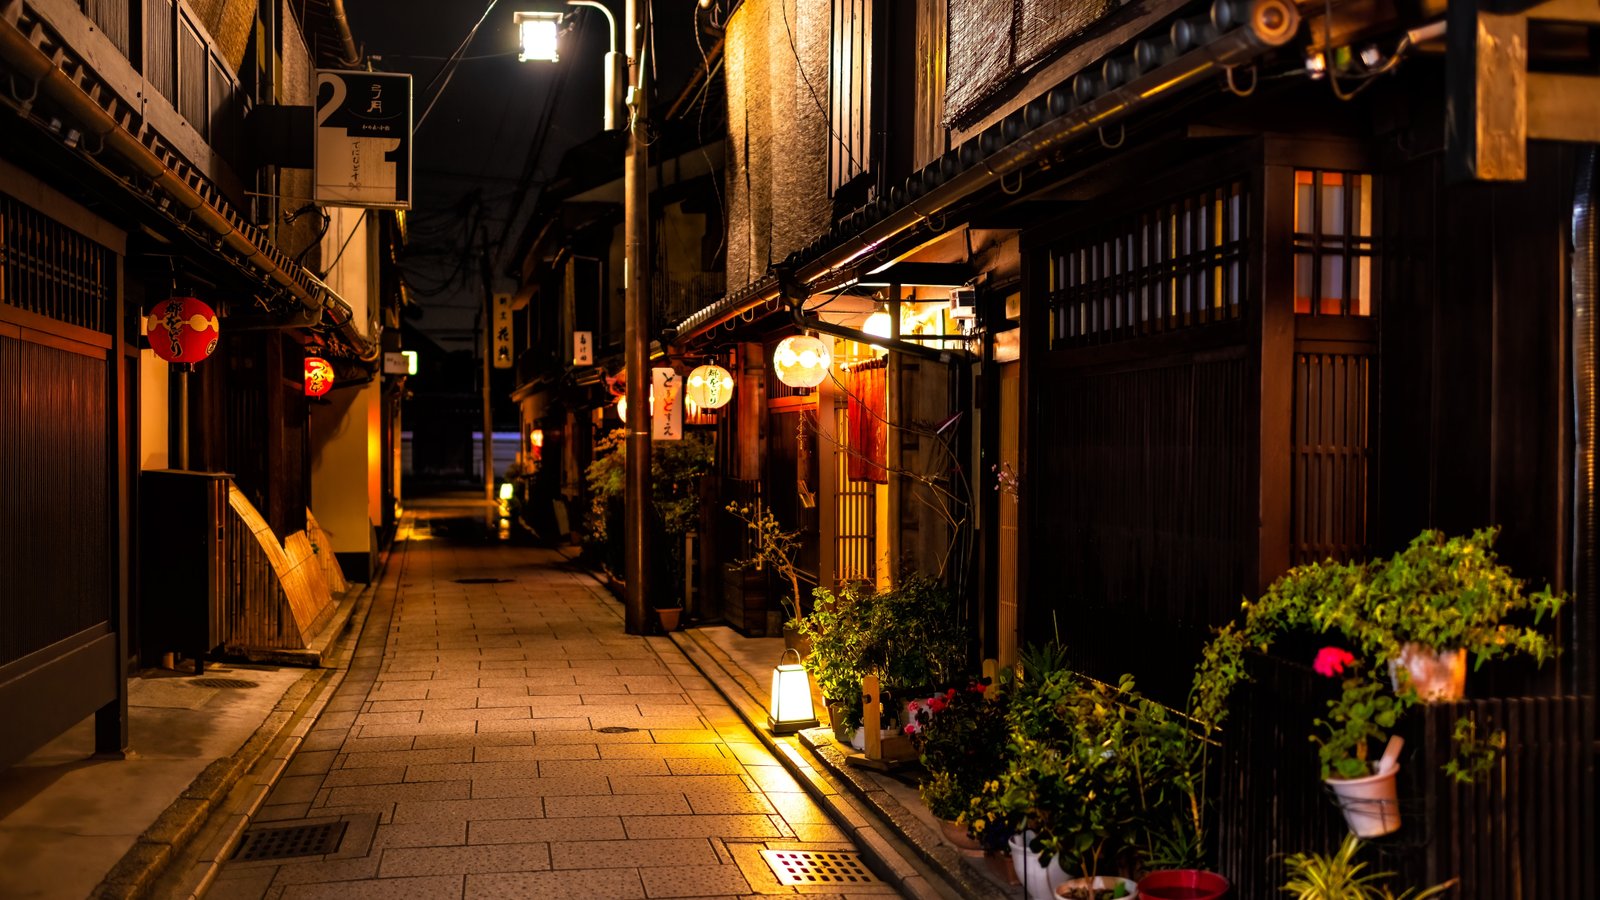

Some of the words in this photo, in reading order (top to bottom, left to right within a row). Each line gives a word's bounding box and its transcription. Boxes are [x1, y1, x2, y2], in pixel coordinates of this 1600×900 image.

[662, 371, 676, 436] どうどすえ
